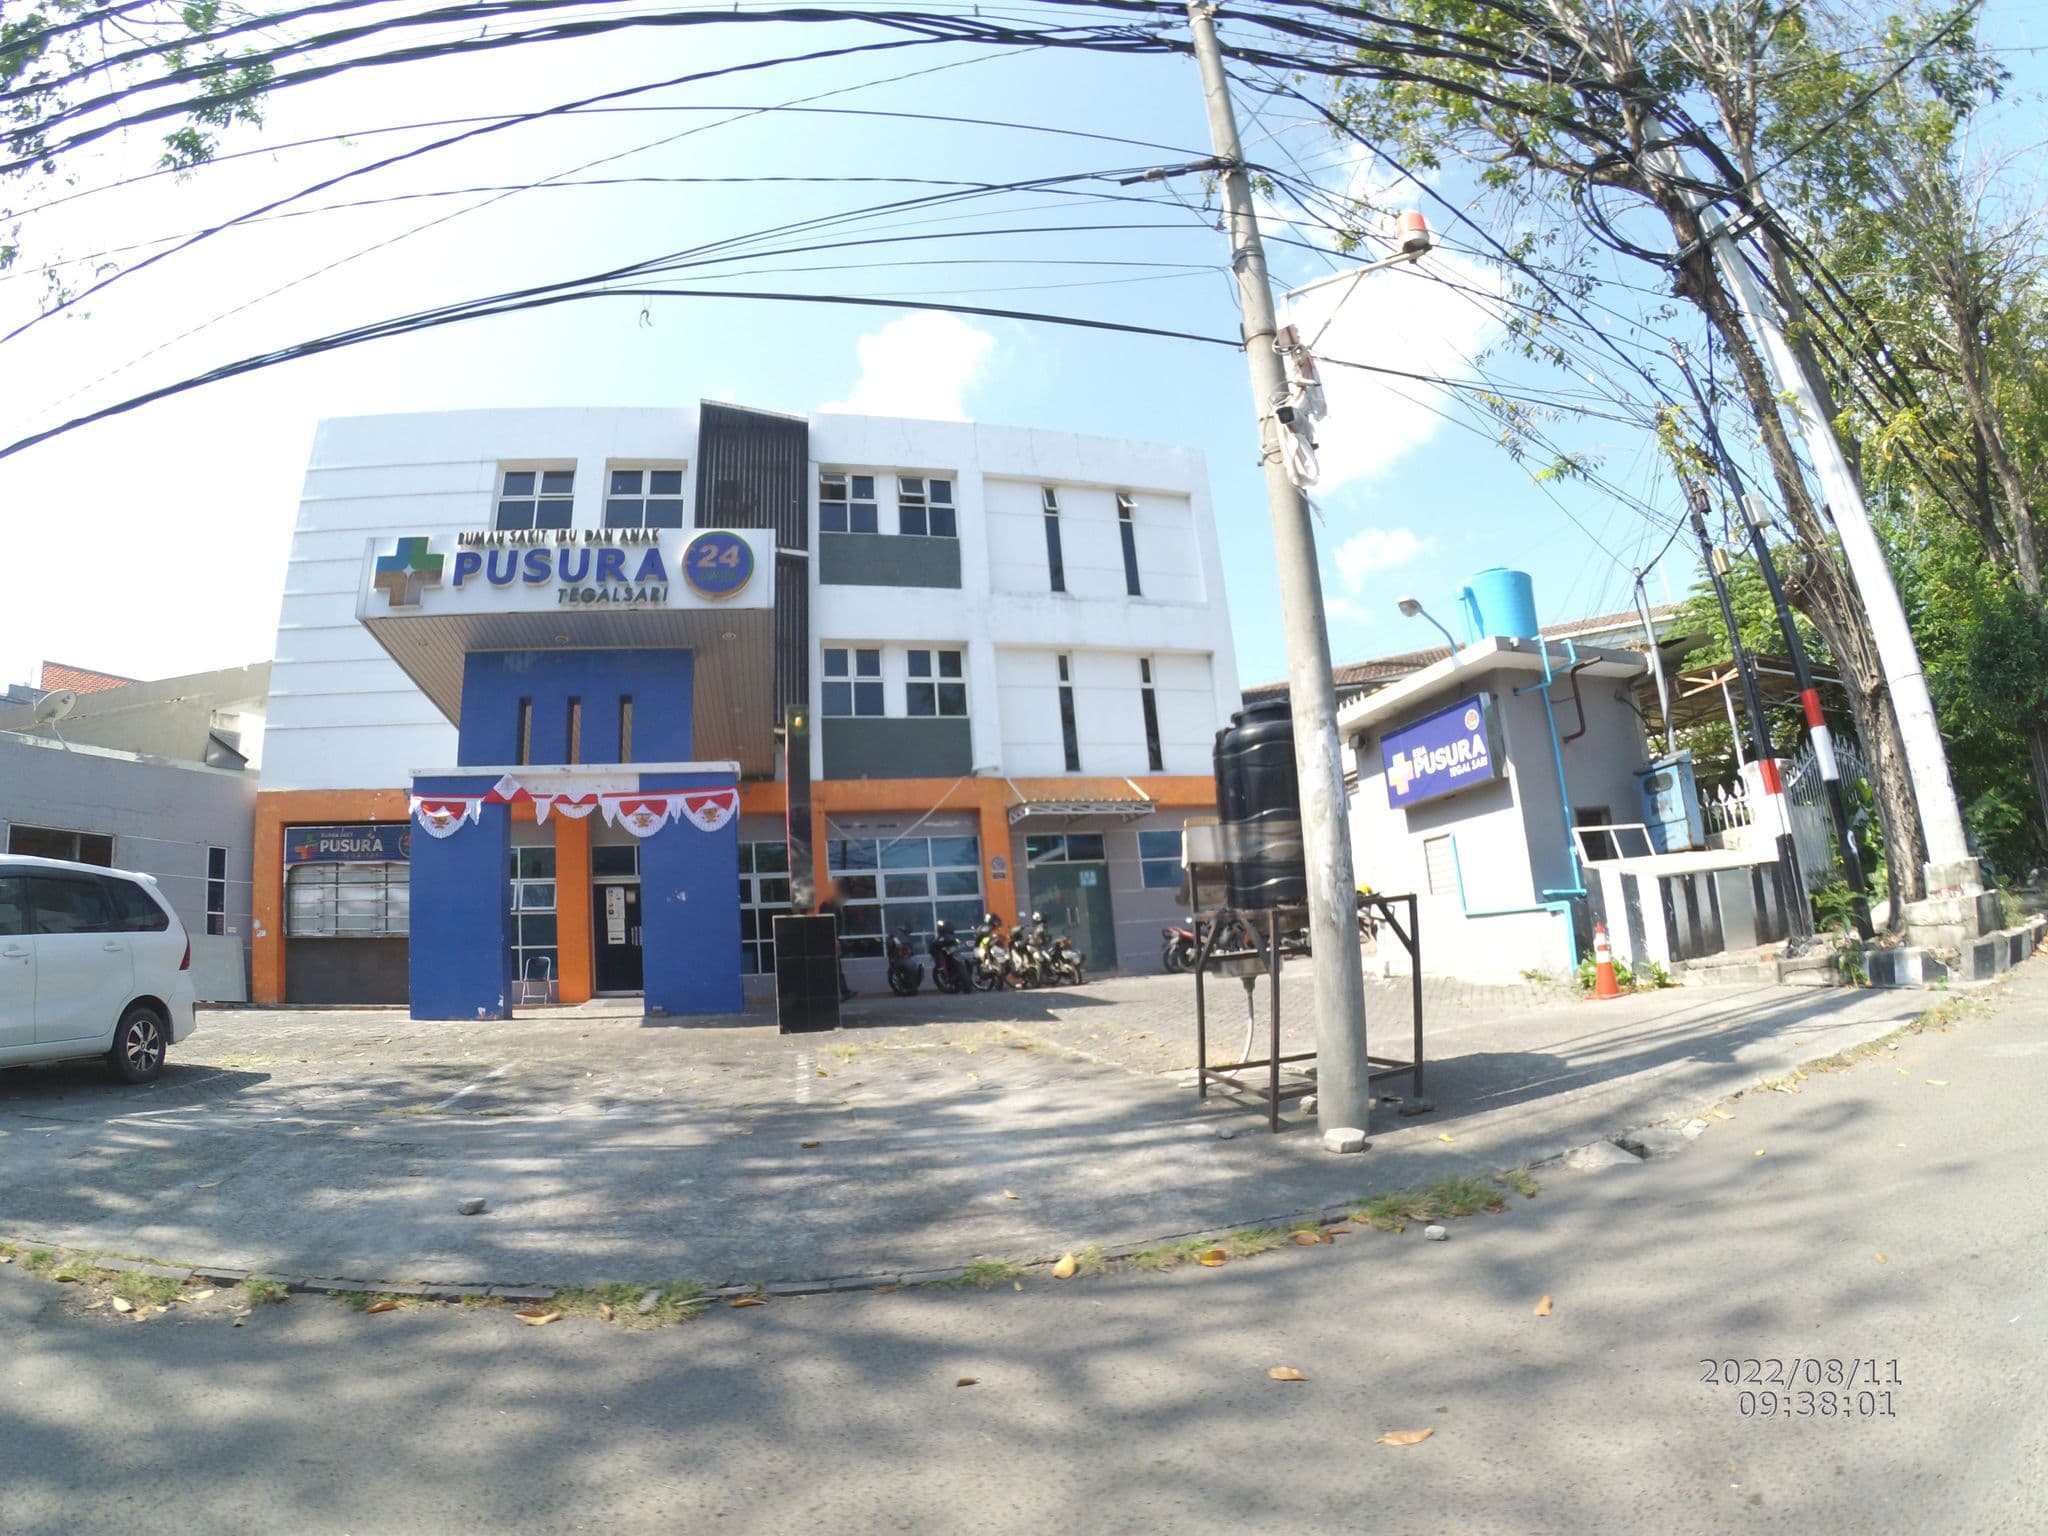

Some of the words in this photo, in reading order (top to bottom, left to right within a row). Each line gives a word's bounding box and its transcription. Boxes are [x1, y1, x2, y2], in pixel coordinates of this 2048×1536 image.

[458, 531, 504, 546] RUMAH
[508, 529, 548, 545] SAKIT
[555, 529, 577, 542] IBU
[584, 529, 614, 543] DAN
[619, 528, 660, 542] ANAK
[698, 544, 740, 568] 24
[452, 547, 669, 587] PUSURA
[558, 587, 669, 604] TEGALSARI
[1412, 734, 1486, 778] PUSURA
[320, 839, 383, 852] PUSURA
